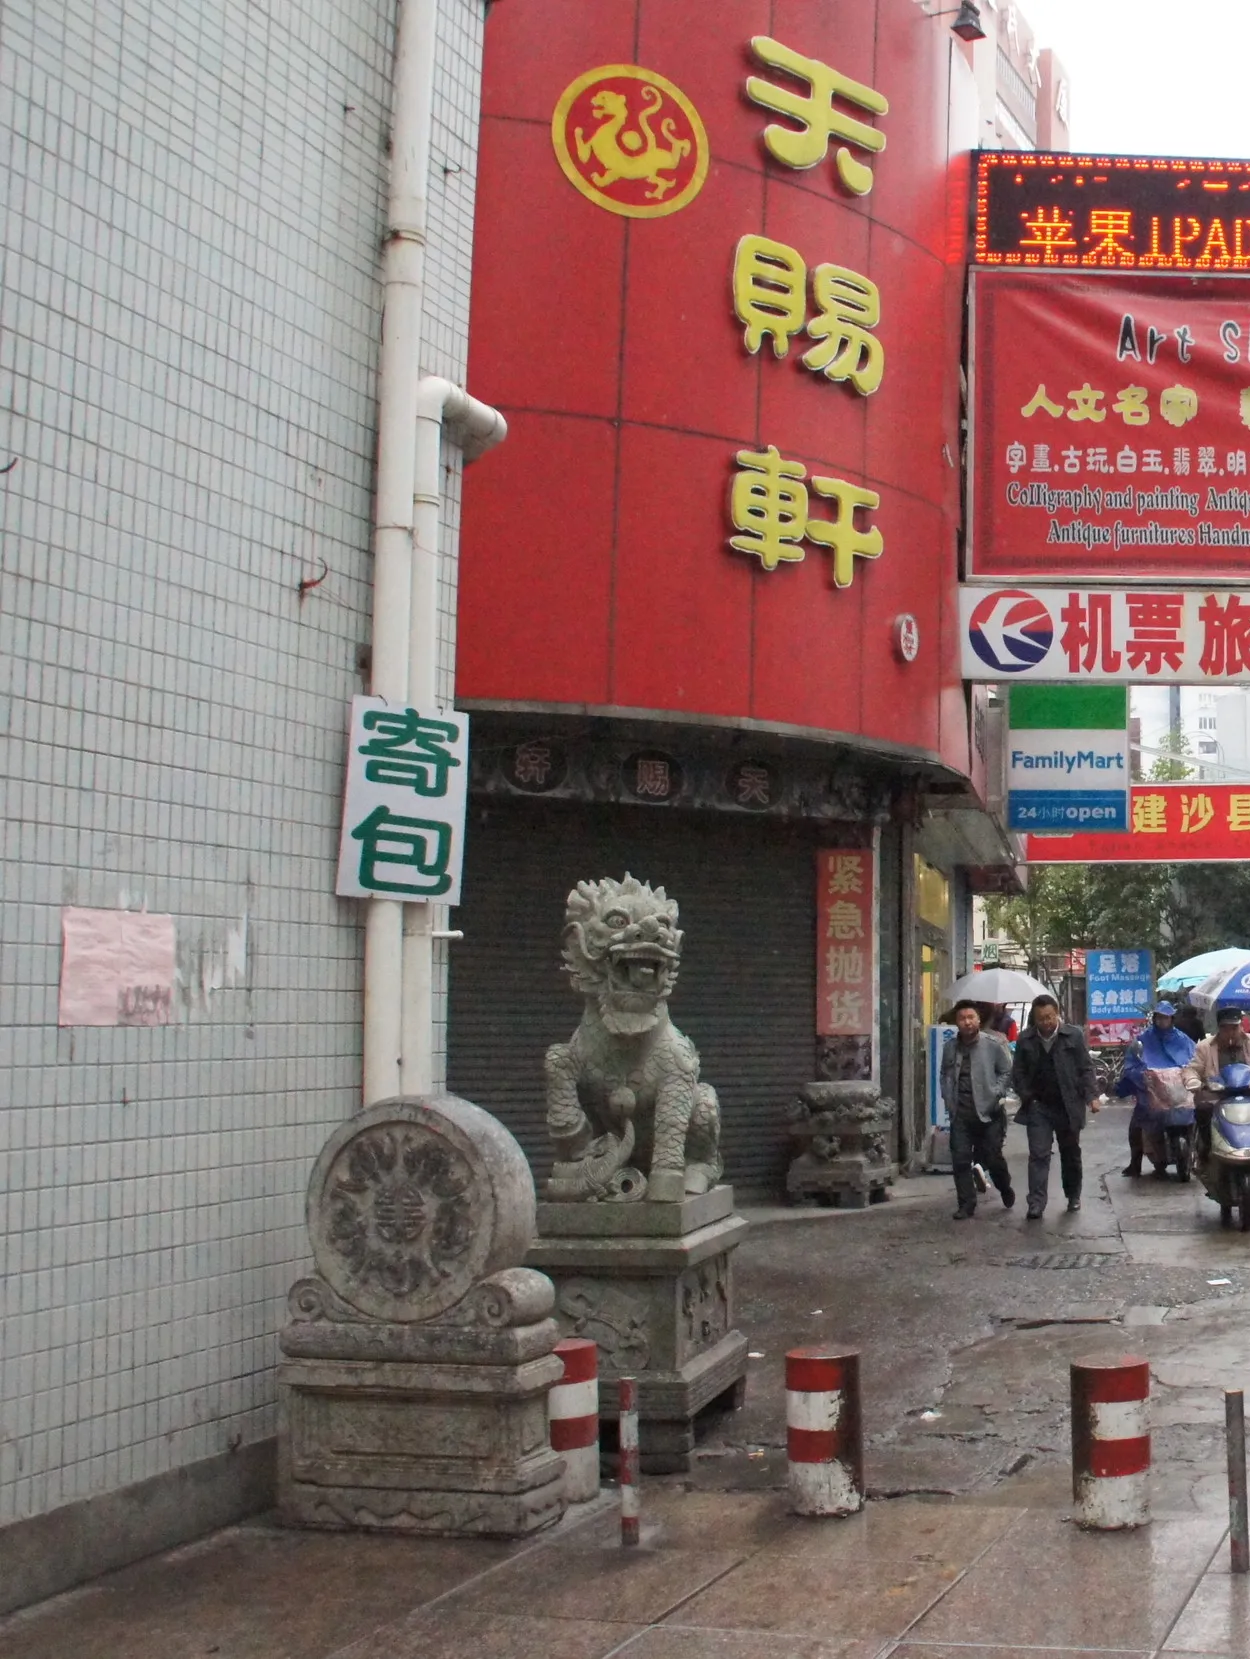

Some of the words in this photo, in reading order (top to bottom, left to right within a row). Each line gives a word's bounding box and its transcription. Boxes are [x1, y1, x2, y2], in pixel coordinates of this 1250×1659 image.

[1117, 313, 1195, 364] Art
[1020, 383, 1199, 427] 人文名家
[1105, 484, 1133, 509] and
[1136, 486, 1200, 516] painting
[1047, 519, 1110, 550] Antique
[1113, 520, 1195, 551] furnitures
[1011, 751, 1124, 773] FamilyMart
[351, 707, 461, 896] 寄包
[826, 855, 865, 1029] 紧急抛货
[1098, 953, 1140, 974] 足浴
[1091, 989, 1148, 1006] 全身按摩
[1091, 1006, 1111, 1014] Body
